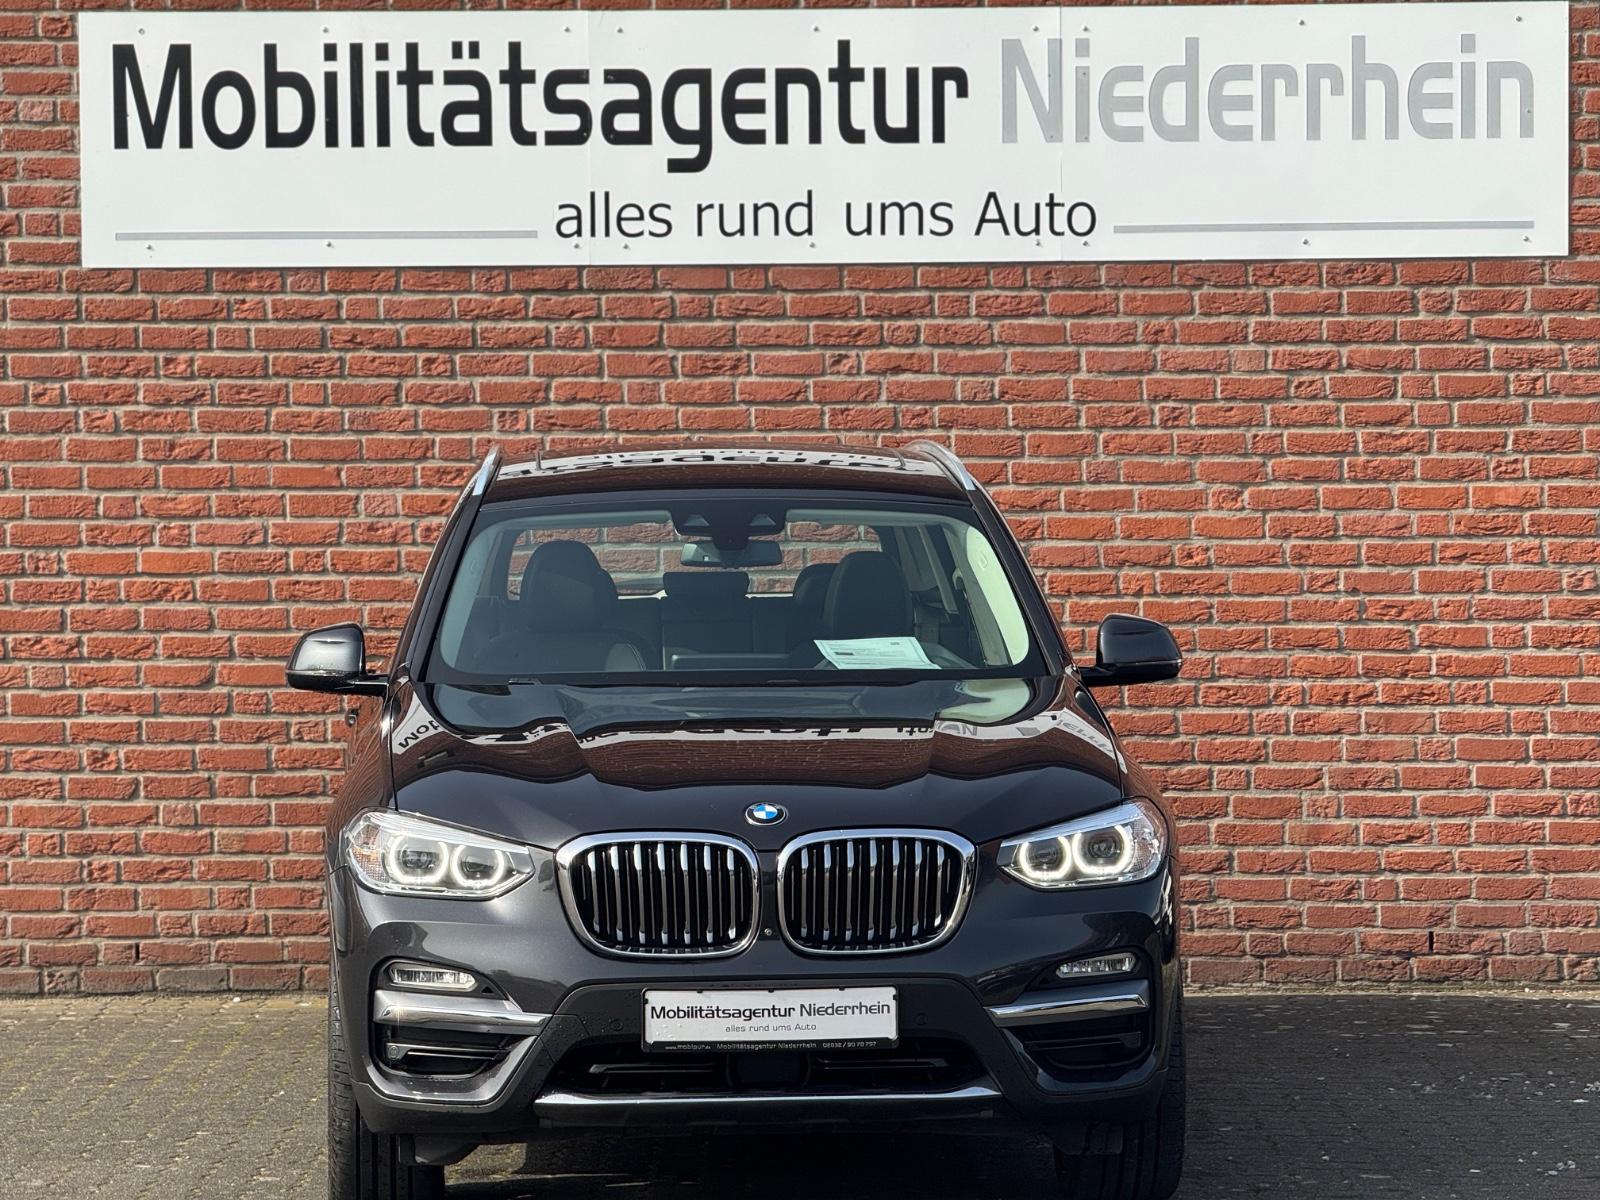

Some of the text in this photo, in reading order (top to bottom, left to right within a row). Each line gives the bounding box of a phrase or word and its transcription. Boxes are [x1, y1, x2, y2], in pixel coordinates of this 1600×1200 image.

[113, 33, 1534, 173] Mobilitätsagentur Niederrhein
[555, 190, 1097, 239] alles rund ums Auto
[650, 1001, 891, 1021] Mobilitätsagentur Niederrhein
[725, 1024, 746, 1033] alles
[749, 1024, 770, 1032] rund
[794, 1023, 817, 1031] Auto
